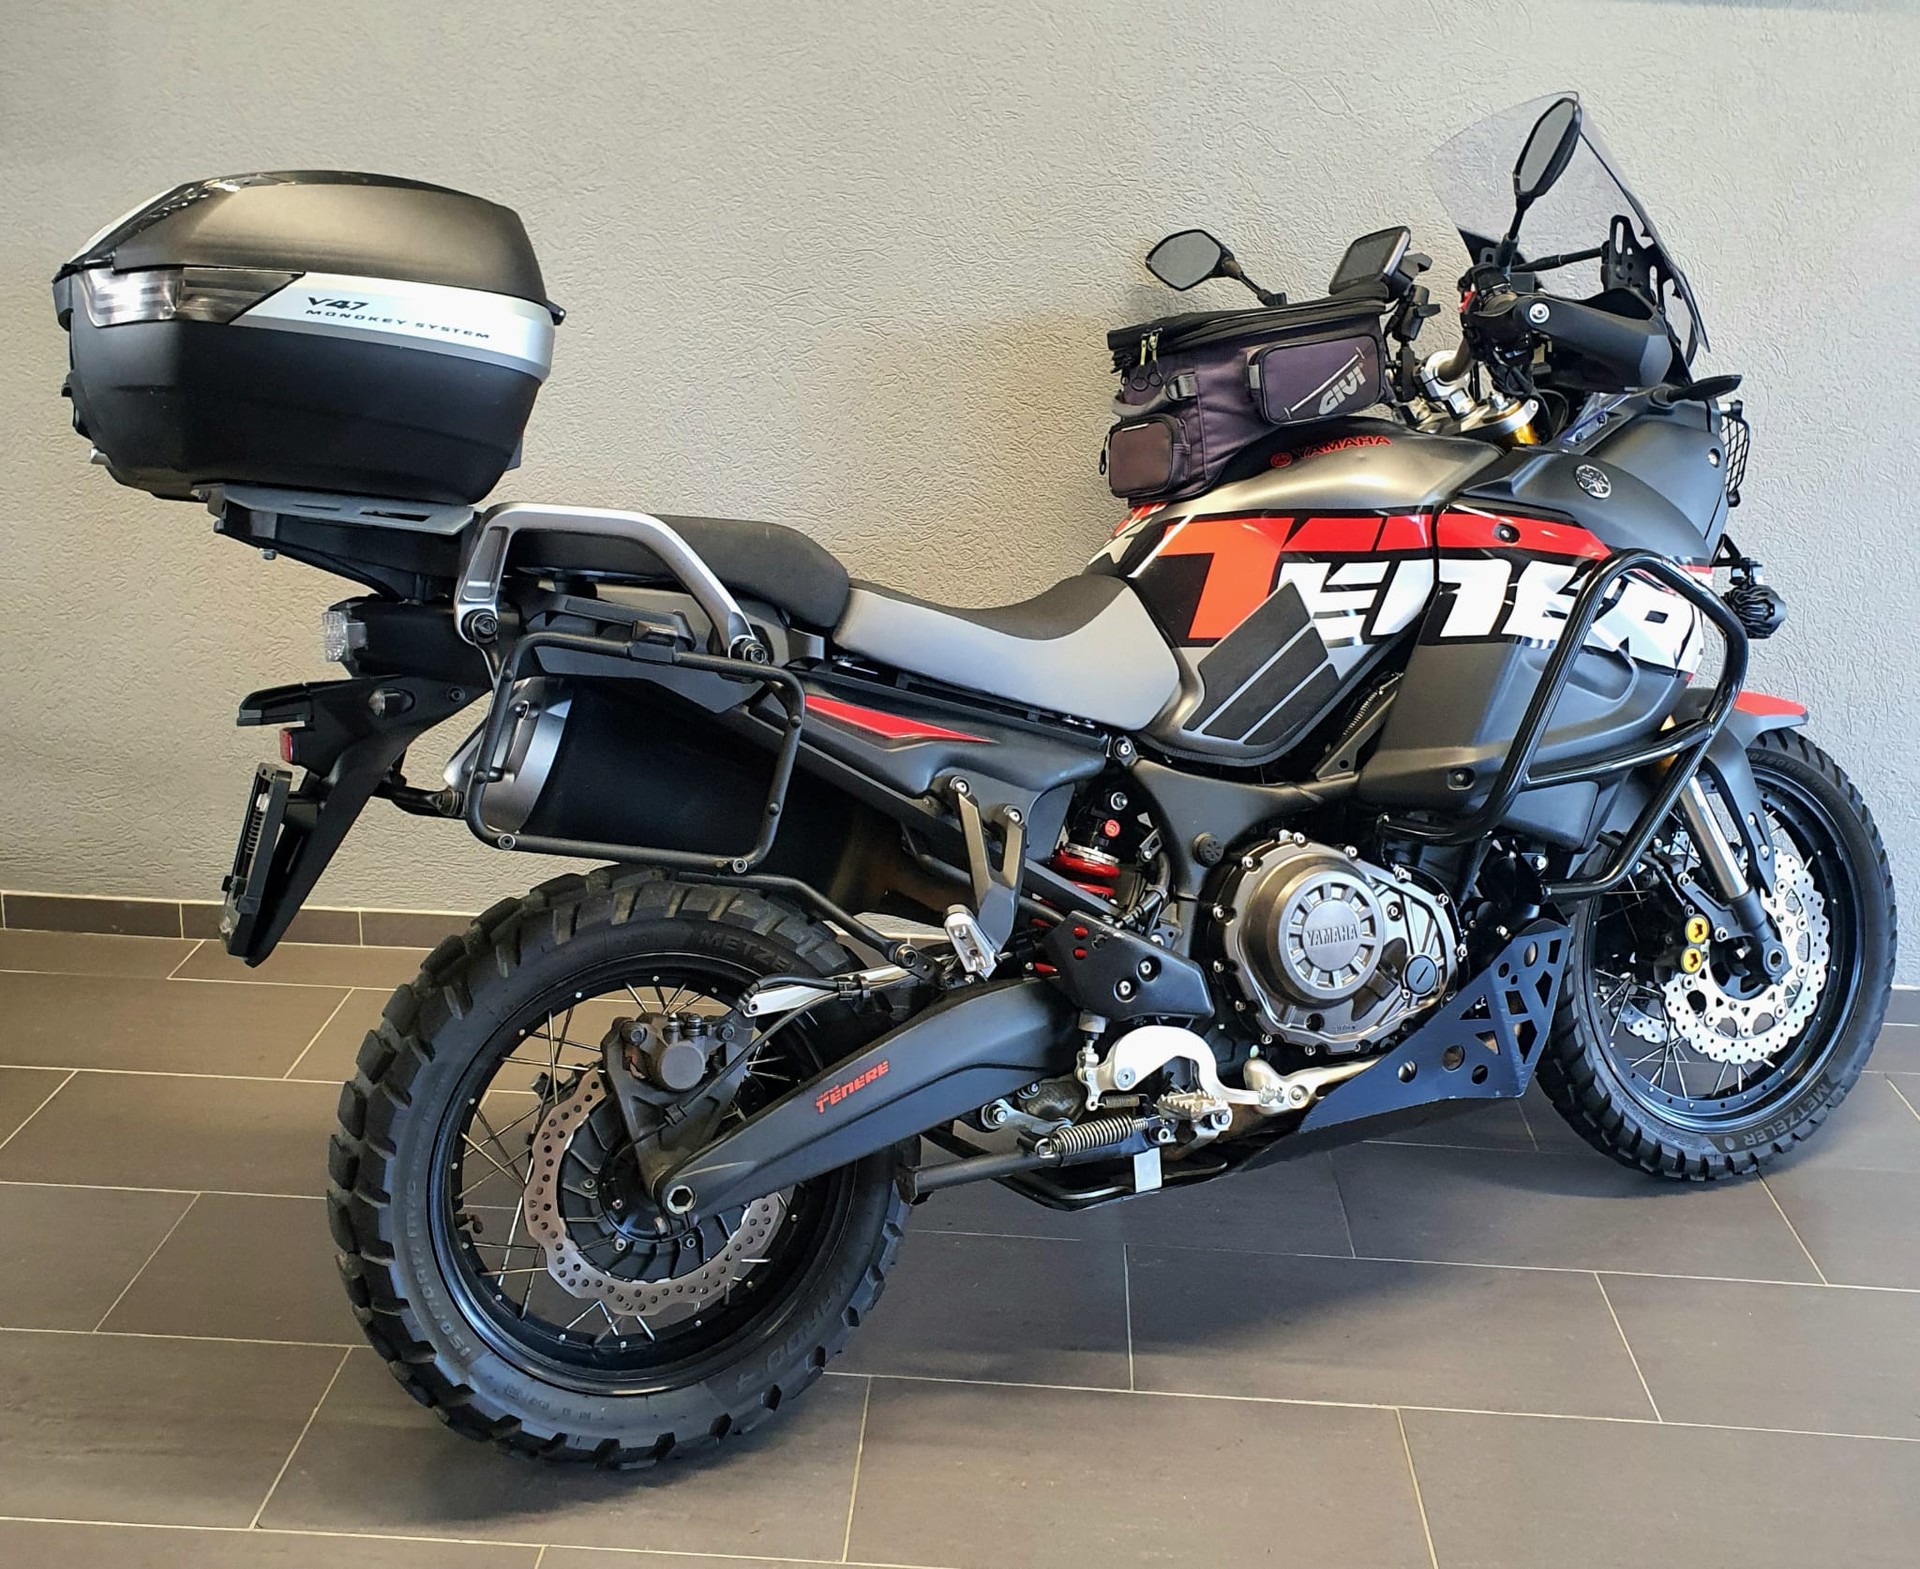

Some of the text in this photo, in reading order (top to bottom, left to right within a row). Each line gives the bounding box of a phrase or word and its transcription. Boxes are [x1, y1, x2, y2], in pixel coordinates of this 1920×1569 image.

[307, 296, 369, 311] V47
[305, 310, 489, 338] MONOKEY SYSTEM
[1318, 363, 1366, 415] GIVI
[1298, 436, 1392, 458] YAMAHA
[1306, 924, 1358, 946] YAMAHA
[1744, 1083, 1831, 1146] METZELER
